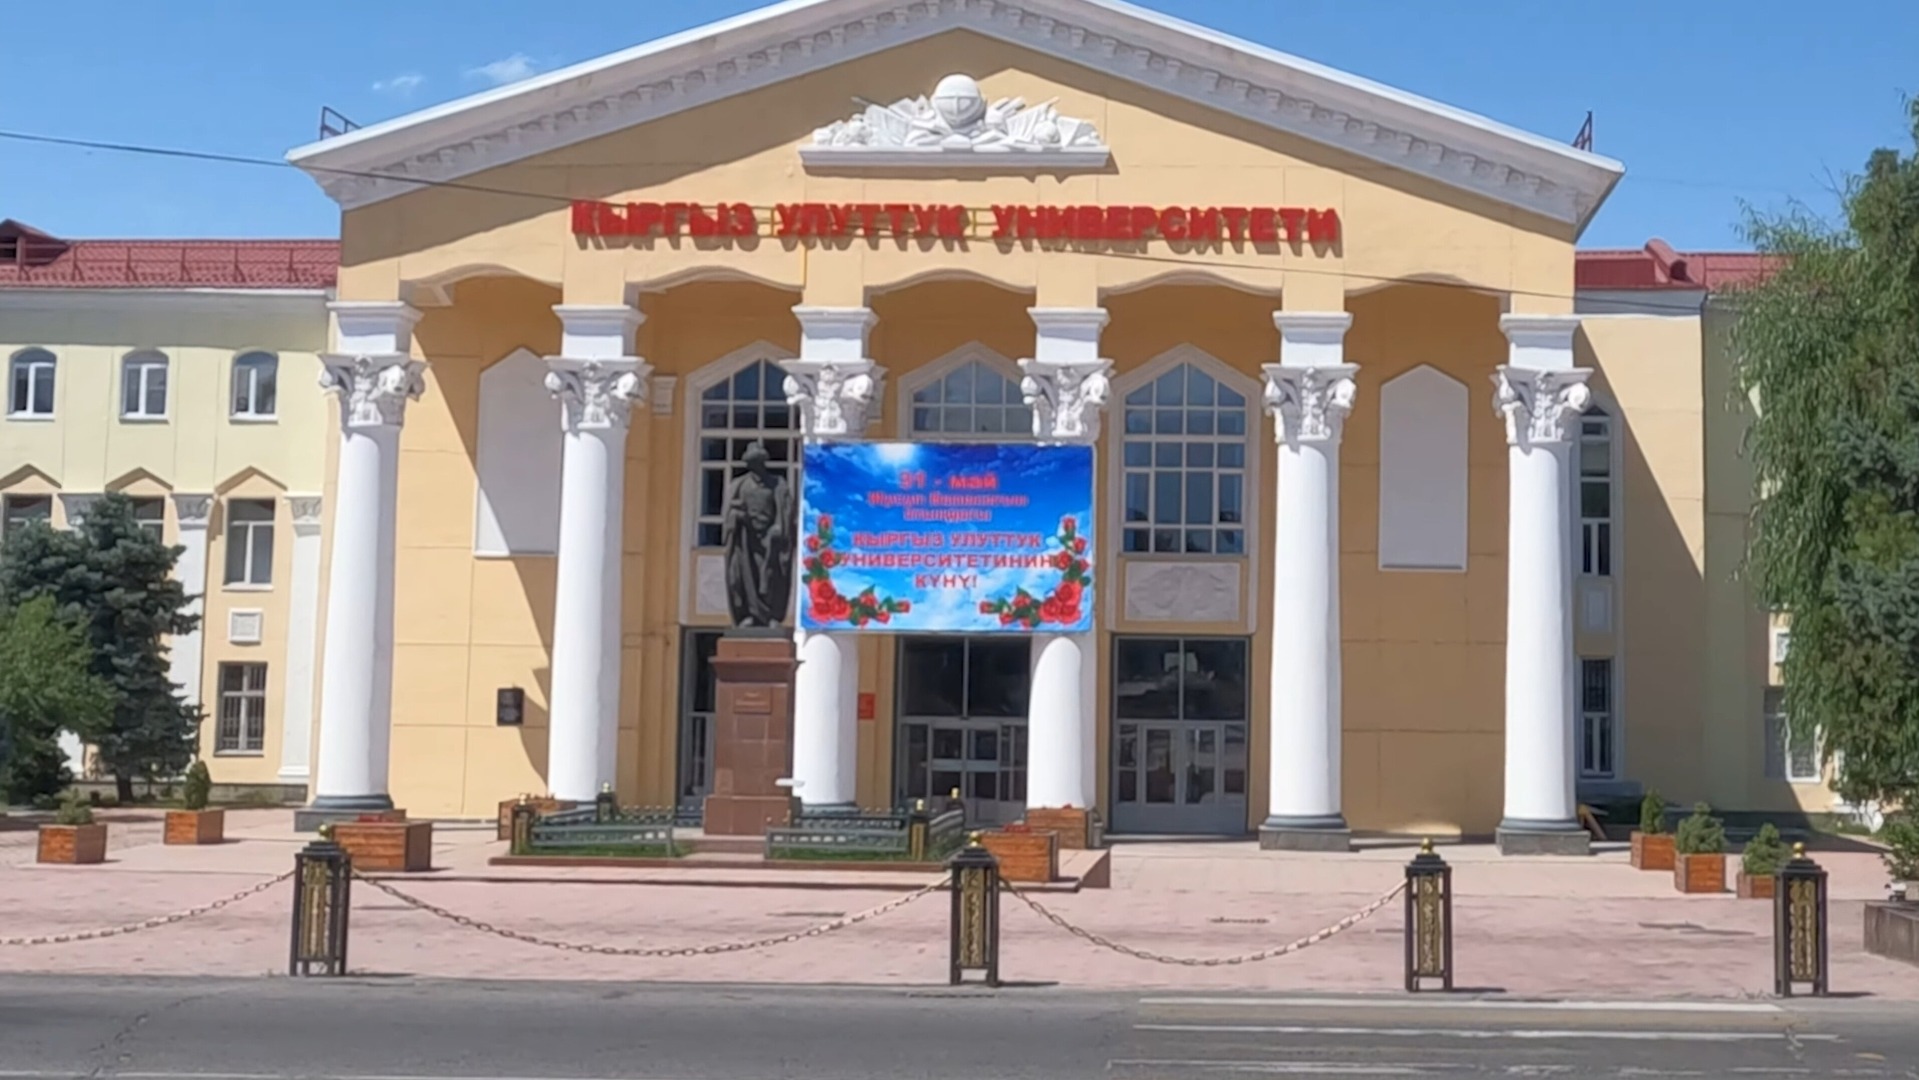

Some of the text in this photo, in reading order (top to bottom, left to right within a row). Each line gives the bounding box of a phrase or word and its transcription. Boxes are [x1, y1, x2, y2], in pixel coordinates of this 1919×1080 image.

[571, 200, 1341, 243] КЫРГЫЗ УЛУТТУК УНИВЕРСИТЕТИ
[900, 470, 927, 489] 31
[949, 471, 998, 489] май
[853, 531, 1042, 548] КЫРГЫЗ УЛУТТУК
[840, 553, 1054, 568] УНИВЕРСИТЕТИНИН
